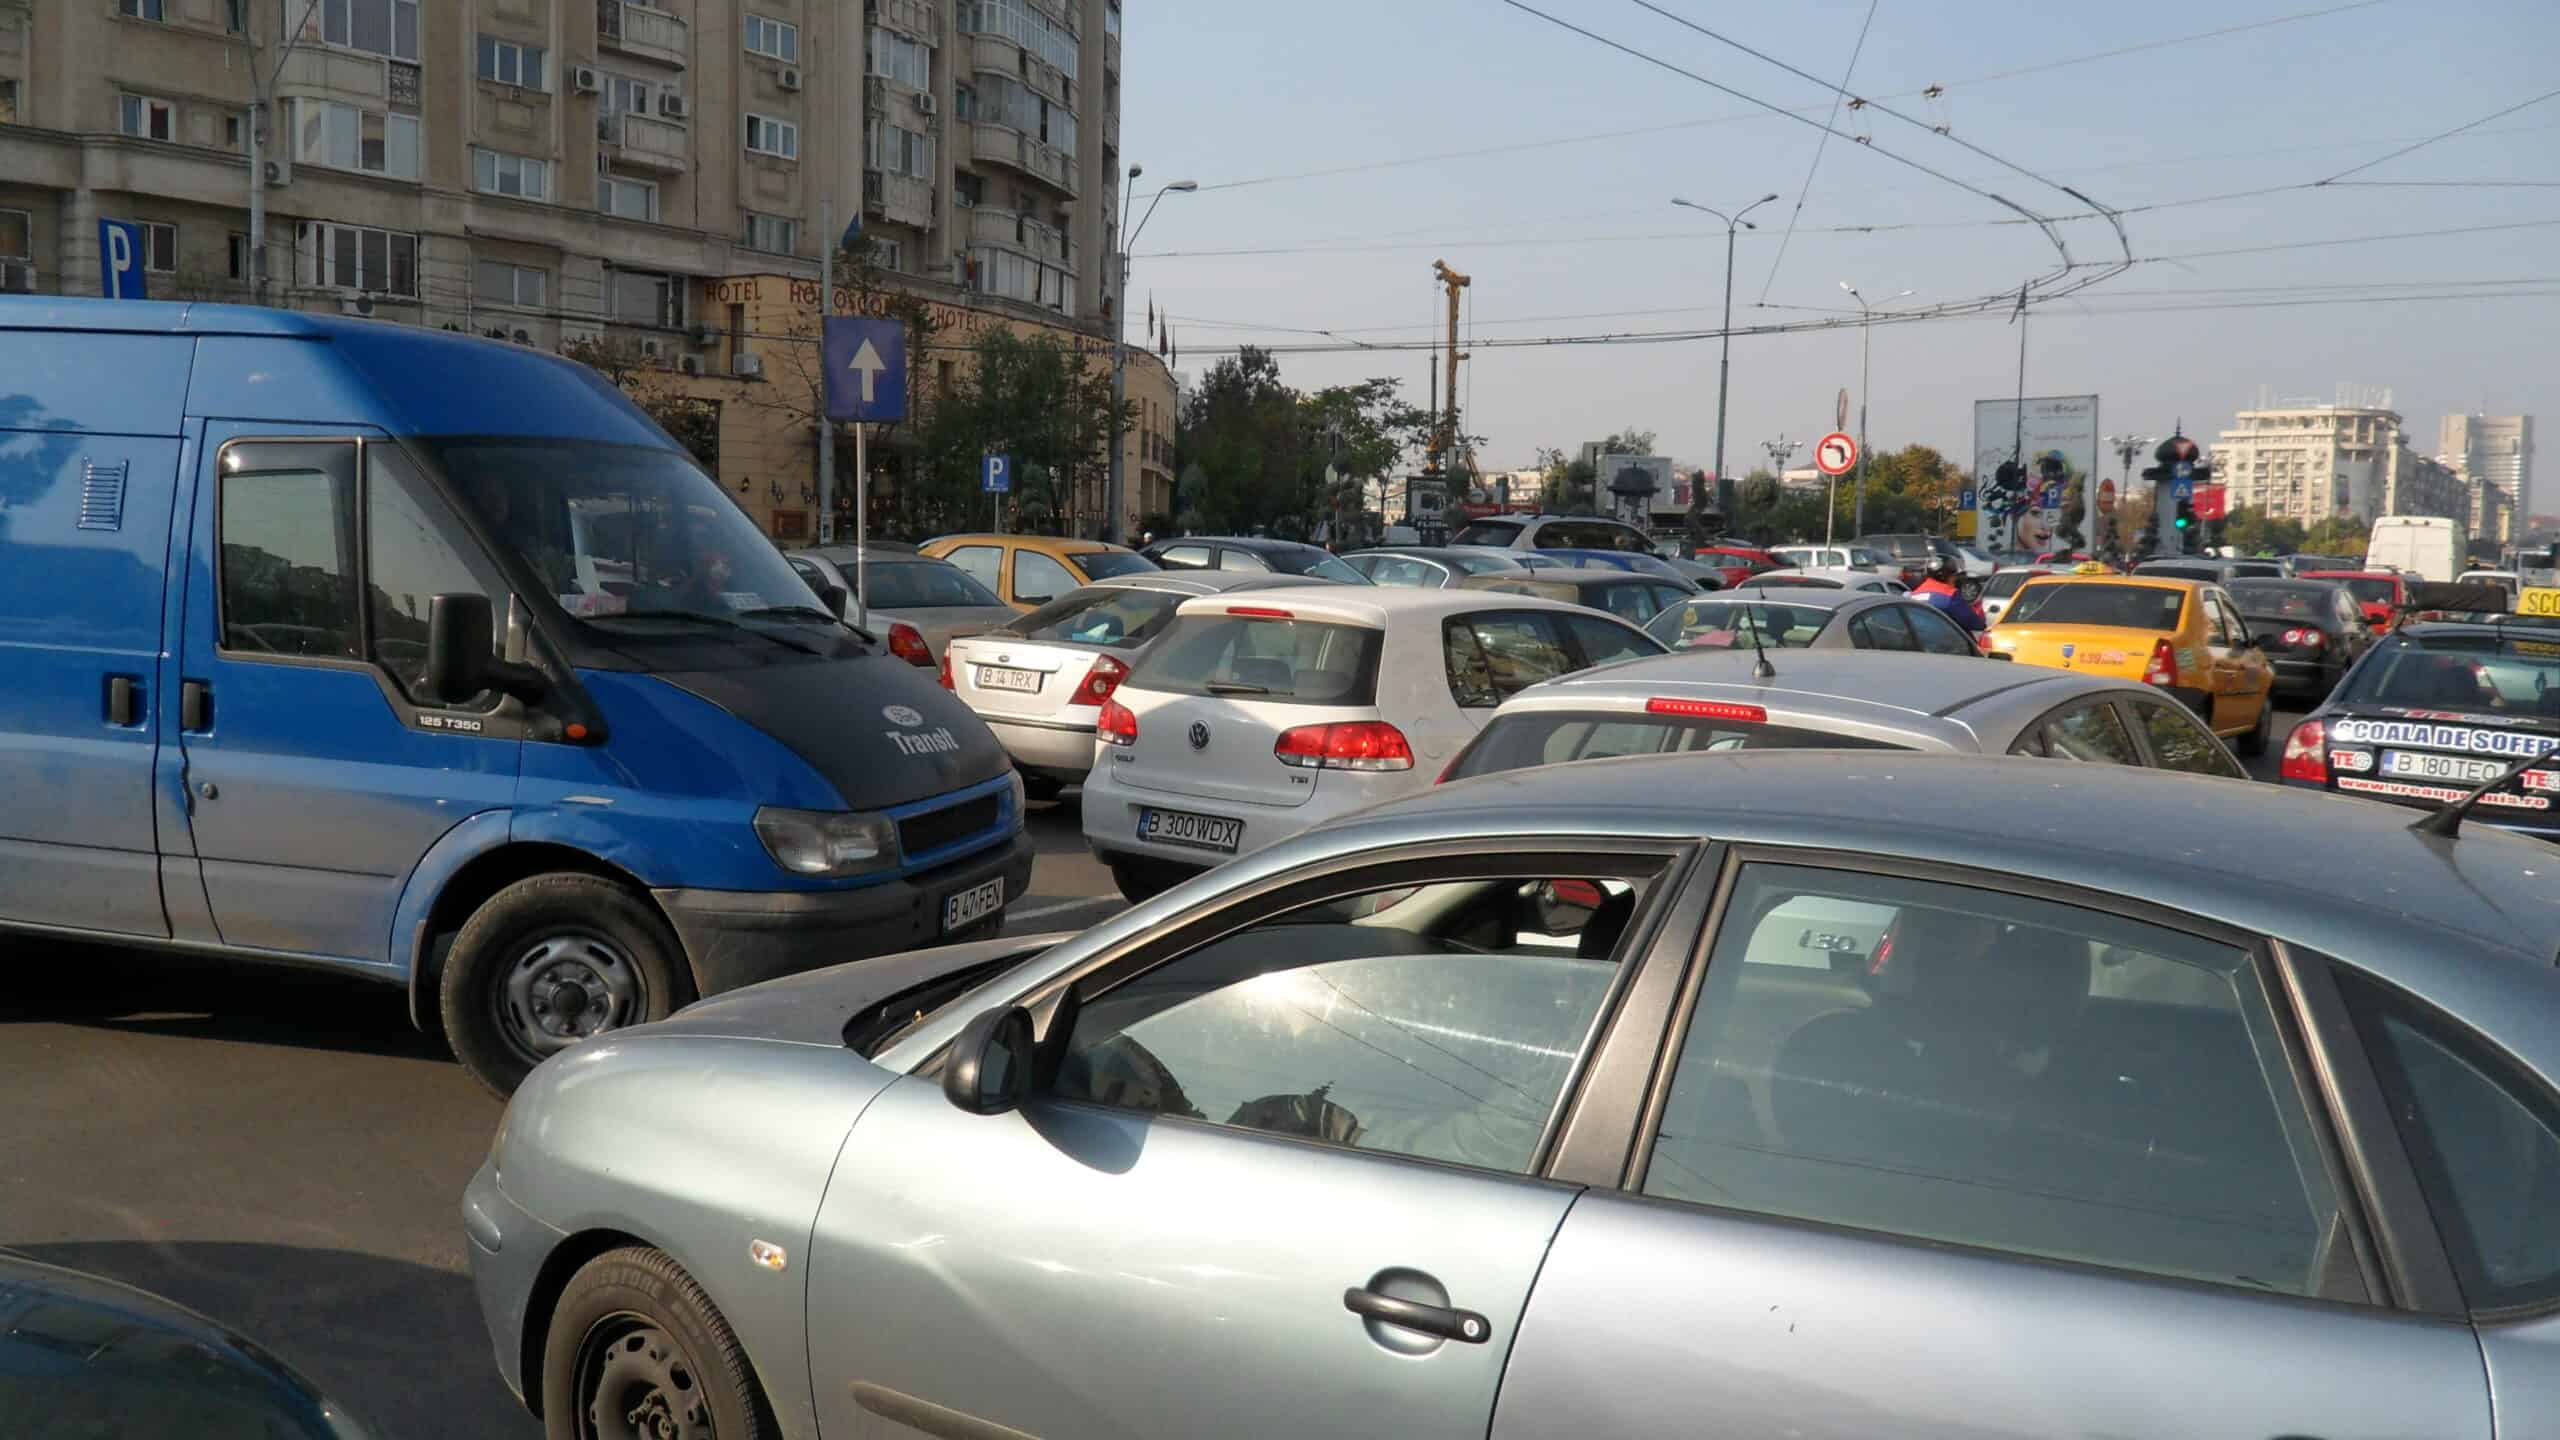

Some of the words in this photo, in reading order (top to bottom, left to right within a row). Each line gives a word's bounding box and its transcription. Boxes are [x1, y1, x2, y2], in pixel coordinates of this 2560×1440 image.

[107, 224, 131, 299] P
[705, 280, 762, 301] HOTEL
[989, 457, 1003, 487] P
[983, 669, 992, 683] B
[1010, 671, 1032, 688] TRX
[420, 716, 441, 726] 125
[445, 718, 480, 731] T350
[885, 728, 959, 755] Transit
[2437, 731, 2467, 748] DE
[2474, 732, 2560, 757] SOFER
[2398, 754, 2411, 771] B
[2420, 757, 2450, 775] 180
[2454, 761, 2496, 780] TEO
[1150, 814, 1160, 833] B
[1166, 816, 1195, 837] 300
[1198, 819, 1238, 844] WDX
[951, 897, 958, 922] B
[962, 891, 976, 917] 47
[978, 882, 1000, 912] FEN
